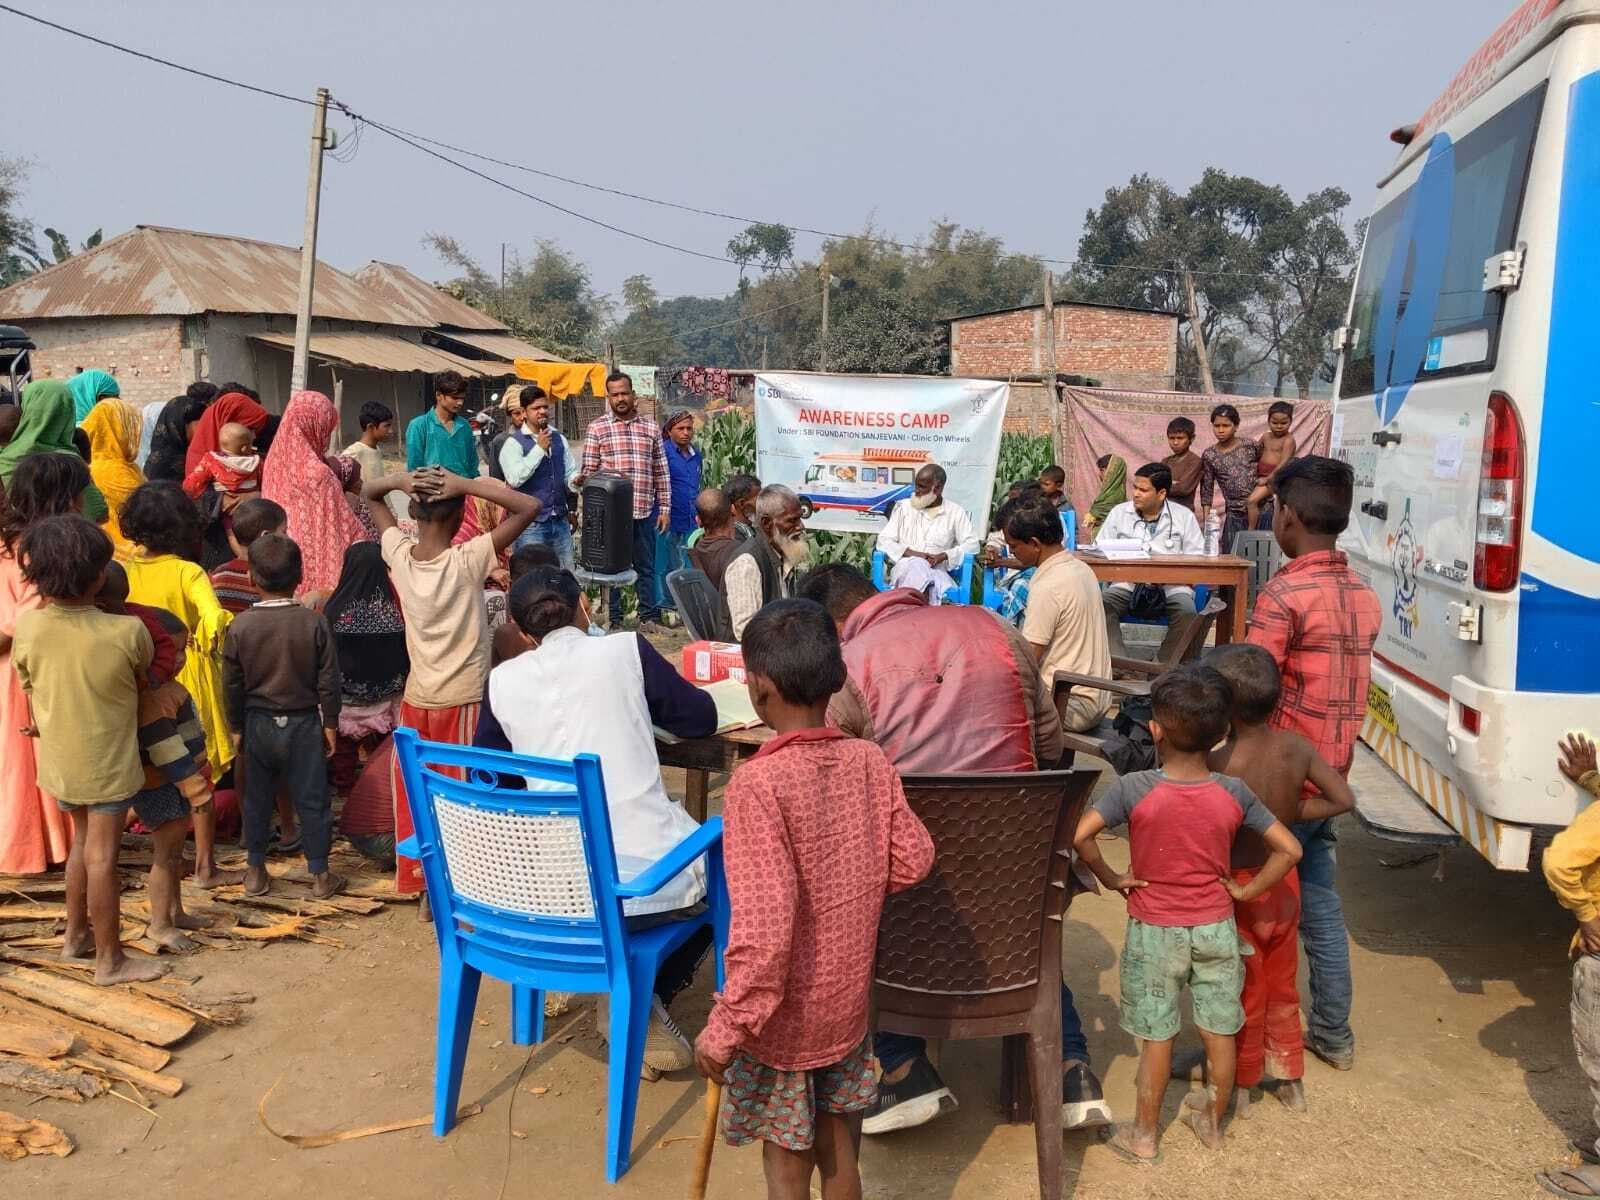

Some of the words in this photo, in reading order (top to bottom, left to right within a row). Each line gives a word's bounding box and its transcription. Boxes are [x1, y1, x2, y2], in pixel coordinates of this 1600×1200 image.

[767, 388, 782, 399] SBI
[799, 408, 895, 428] AWARENESS
[900, 413, 950, 429] CAMP
[777, 427, 798, 435] Under
[815, 429, 860, 439] FOUNDATION
[861, 432, 906, 441] SANJEEVANI
[911, 434, 932, 442] Clinic
[945, 435, 971, 443] Wheels
